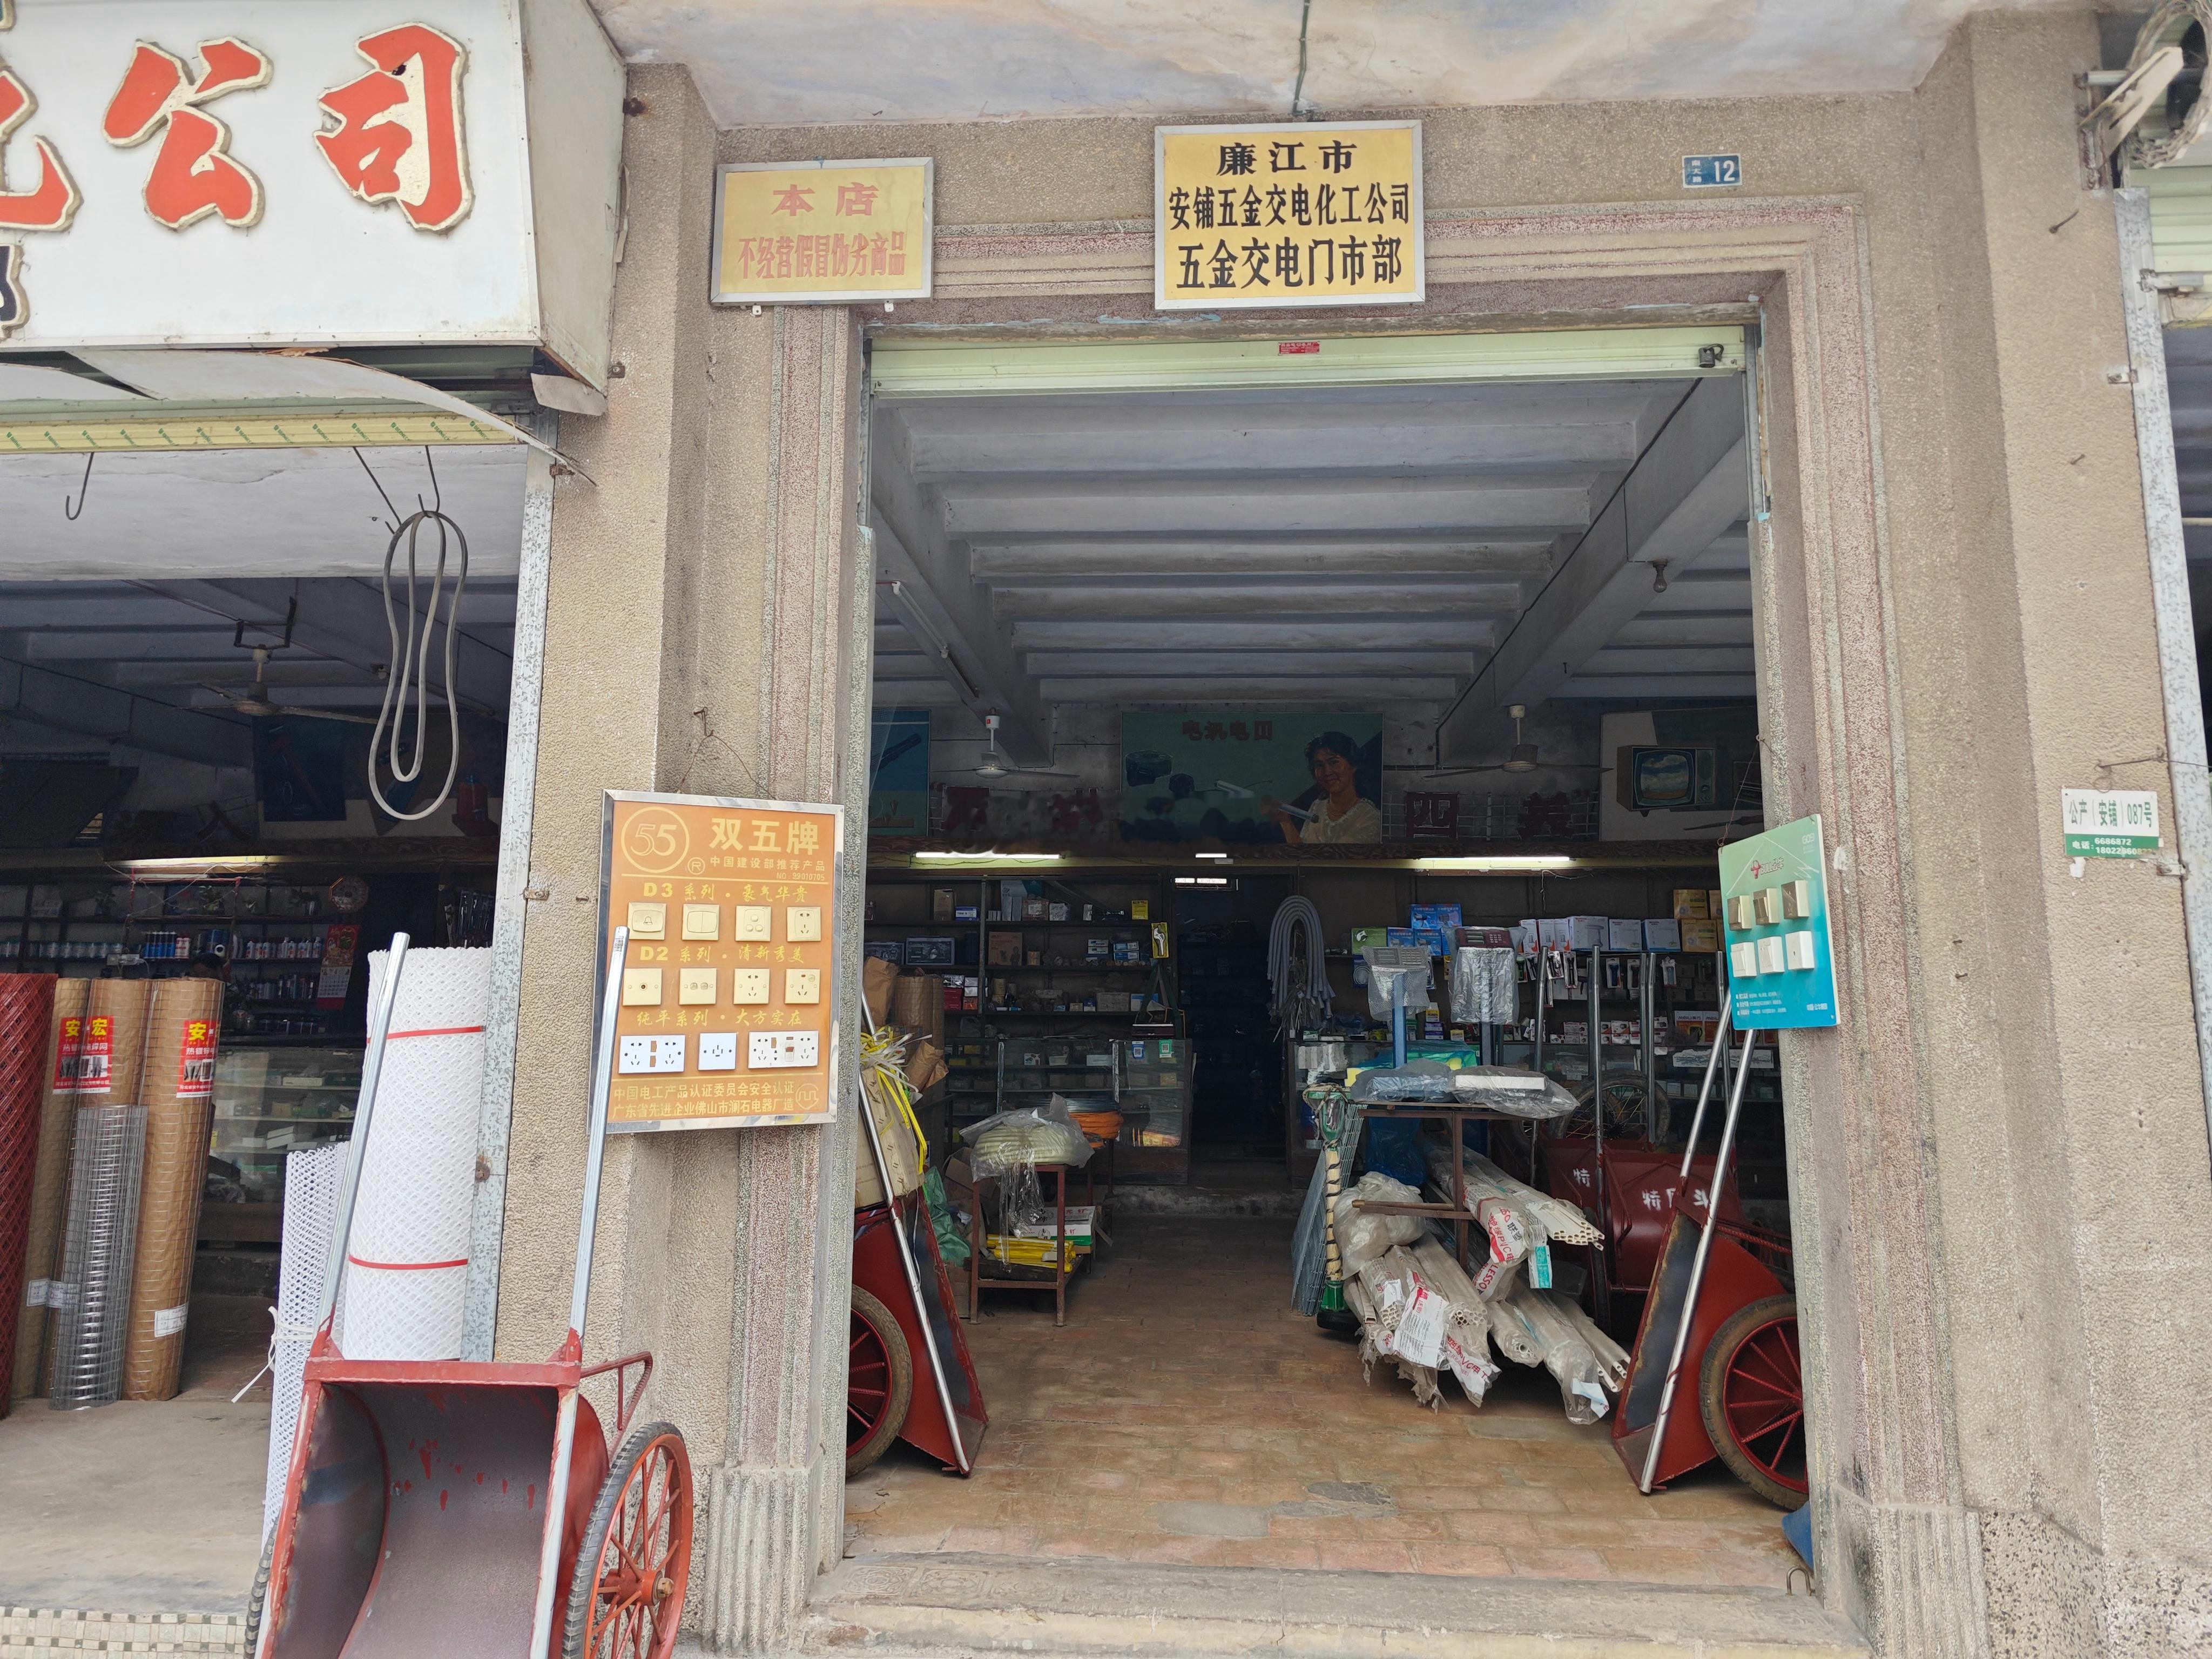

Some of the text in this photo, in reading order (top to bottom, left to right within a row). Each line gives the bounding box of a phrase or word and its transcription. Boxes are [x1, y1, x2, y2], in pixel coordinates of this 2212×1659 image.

[1216, 140, 1357, 176] 廉江市
[1714, 160, 1735, 182] 12
[771, 182, 879, 217] 本店
[1169, 181, 1409, 231] 安铺五金交电化工公司
[738, 231, 907, 279] 不经营假冒伪劣商品
[1176, 234, 1402, 289] 五金交电门市部
[630, 823, 677, 857] 55
[709, 817, 820, 855] 双五牌
[2094, 837, 2132, 846] 6686872
[709, 855, 826, 872] 中国建设部推荐产品
[65, 1017, 108, 1037] 安 宏
[188, 1022, 206, 1041] 安
[613, 1081, 795, 1102] 中国电工产品认证委员会安全认证
[612, 1097, 794, 1120] 广东省先进企业佛山市澜石电器厂造
[1573, 1168, 1591, 1188] 特
[1479, 1264, 1499, 1290] LESSO
